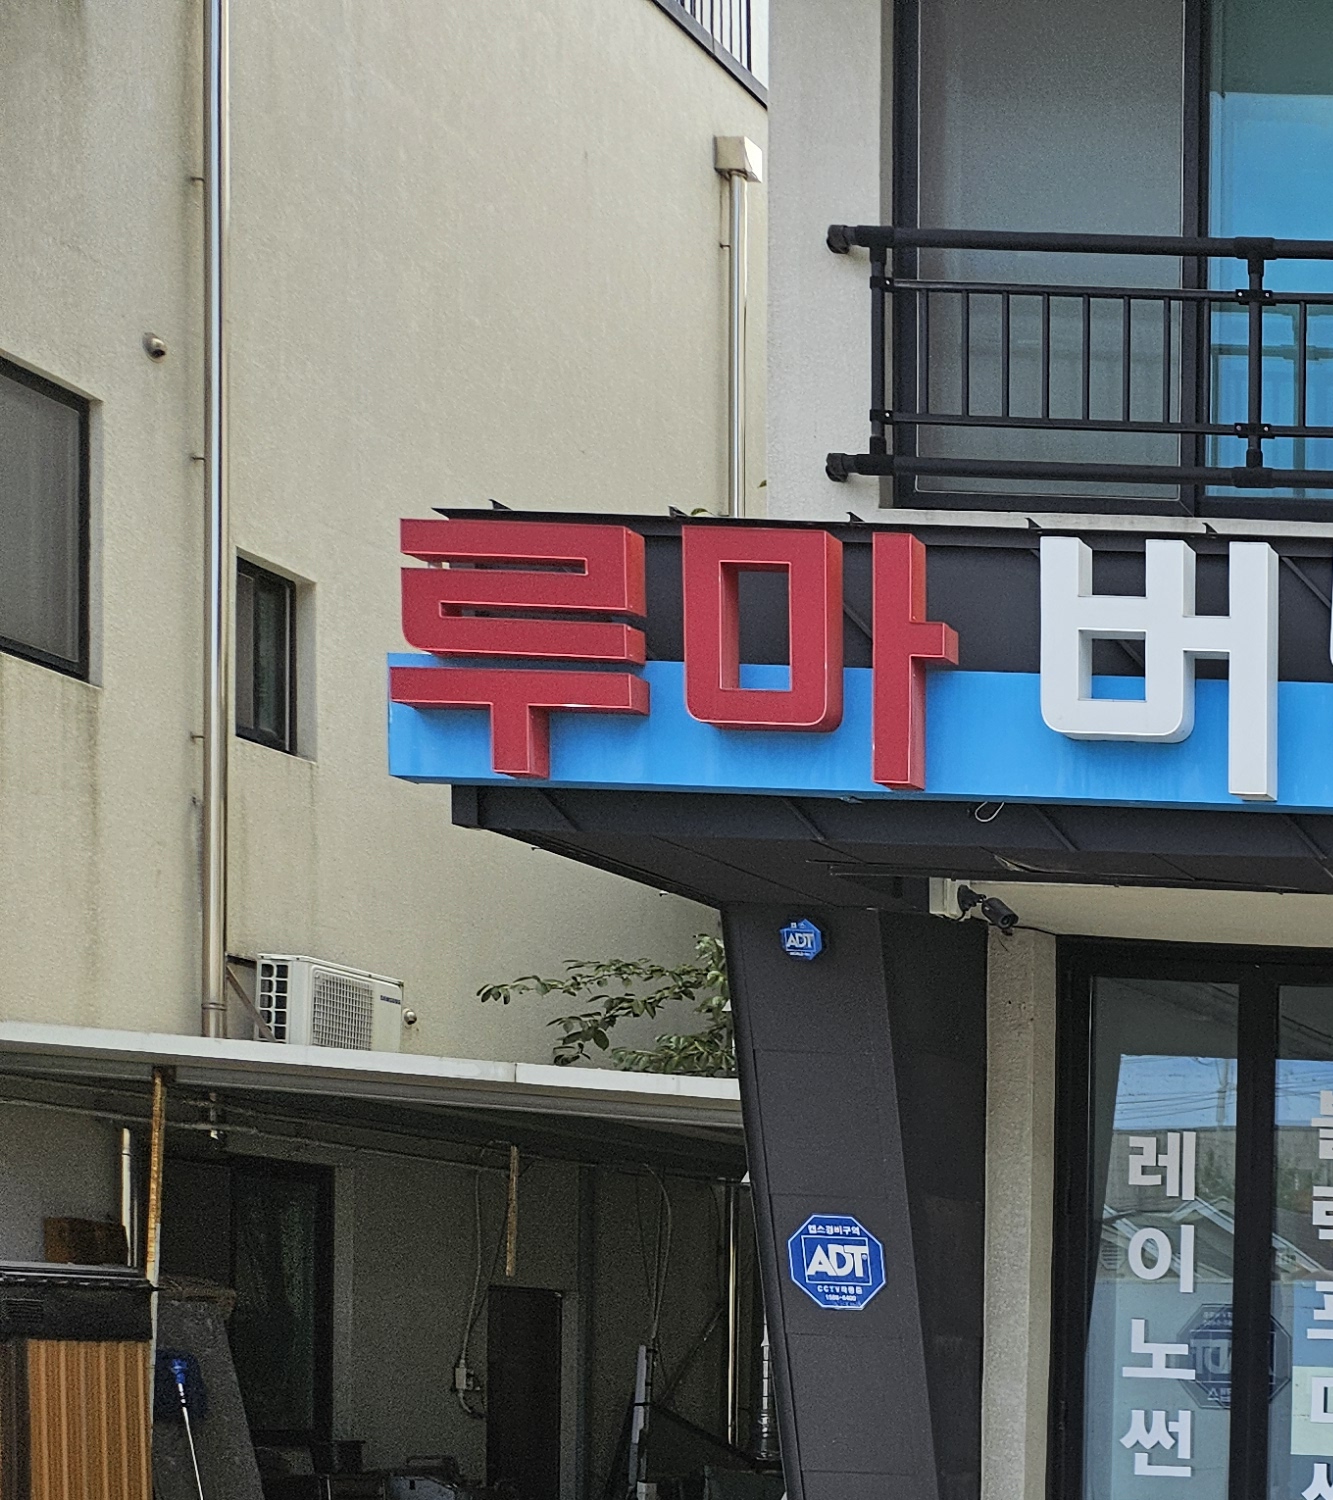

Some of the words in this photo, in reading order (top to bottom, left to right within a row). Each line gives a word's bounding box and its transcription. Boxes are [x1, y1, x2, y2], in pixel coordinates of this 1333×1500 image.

[390, 518, 958, 790] 루마
[786, 932, 814, 949] ADT
[807, 1243, 868, 1278] ADT
